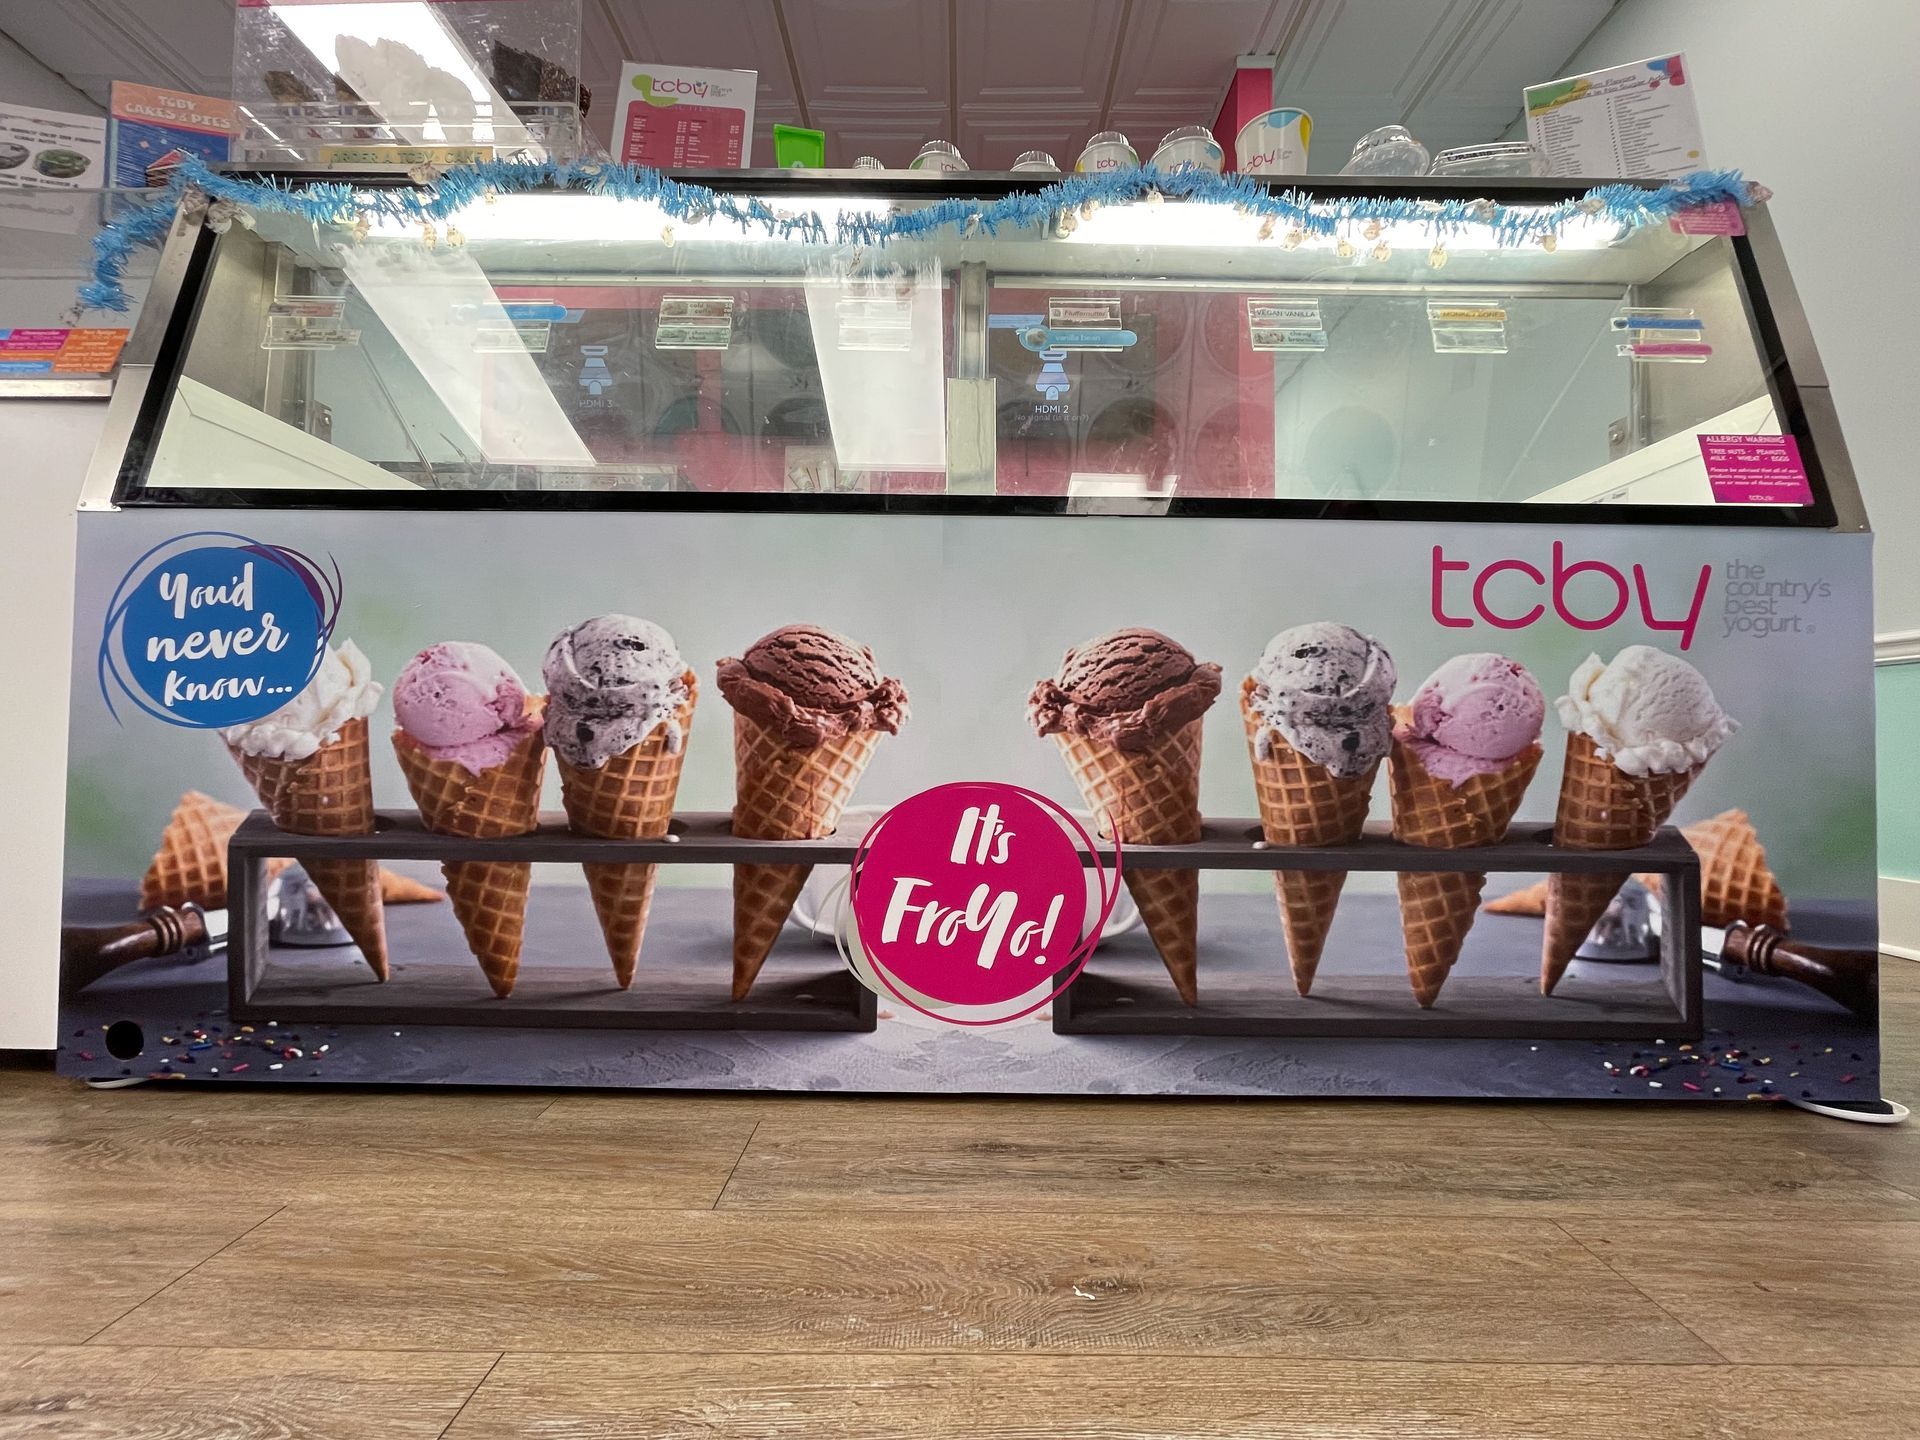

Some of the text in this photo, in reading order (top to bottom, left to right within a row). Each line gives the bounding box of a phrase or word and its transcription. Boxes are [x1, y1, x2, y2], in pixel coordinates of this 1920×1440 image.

[652, 78, 709, 99] tcby
[158, 95, 197, 112] TCBY
[125, 103, 176, 120] CAKES
[191, 114, 231, 129] PIES
[1256, 309, 1316, 318] VEGAN VANILLA
[1035, 404, 1069, 414] HDMI 2
[1706, 435, 1785, 444] ALLERGY WARNING
[1726, 559, 1766, 580] the
[159, 561, 254, 620] You'd
[1431, 540, 1712, 651] tcby
[1725, 578, 1832, 604] country's
[1724, 595, 1779, 615] best
[147, 612, 290, 663] never
[1722, 615, 1803, 639] yogurt
[950, 804, 1017, 866] It's
[881, 876, 1065, 971] FroYo!
